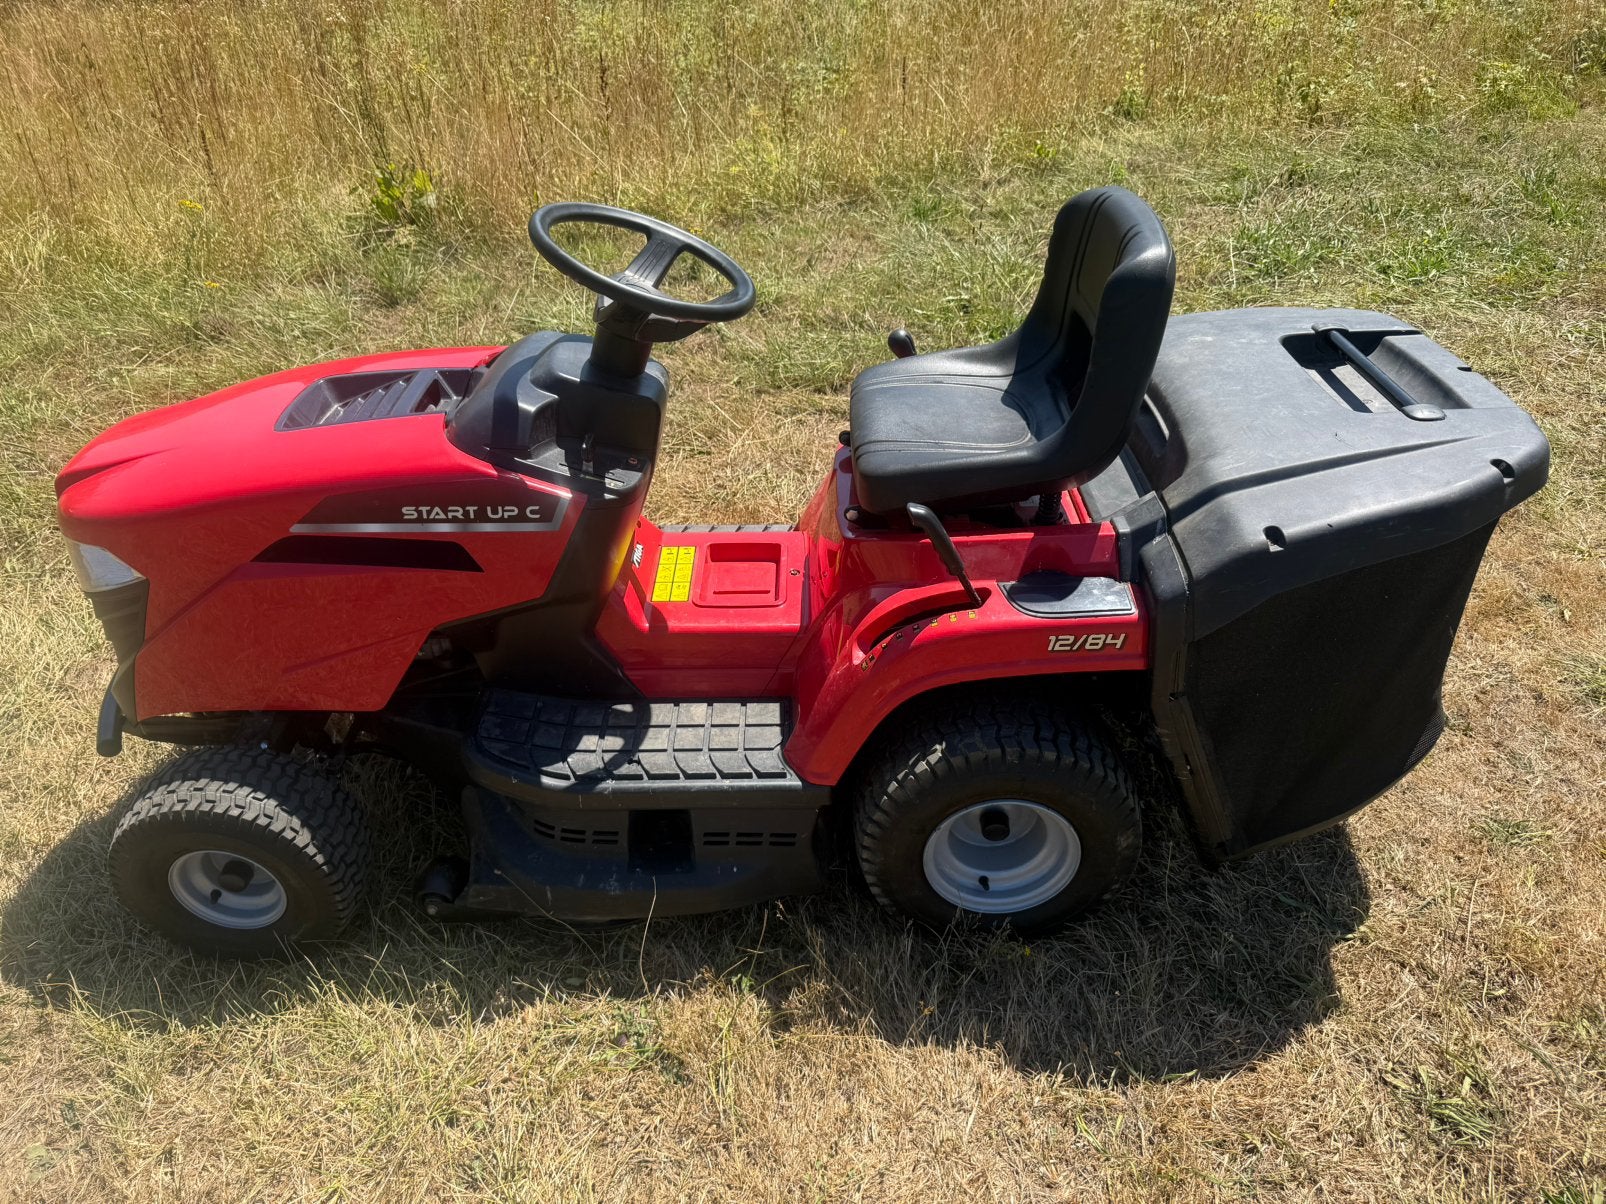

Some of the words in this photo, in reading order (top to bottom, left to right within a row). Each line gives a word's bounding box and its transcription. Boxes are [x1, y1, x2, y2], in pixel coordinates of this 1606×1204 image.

[401, 505, 478, 520] START
[486, 505, 519, 519] UP
[525, 505, 541, 519] C
[1047, 633, 1126, 651] 12/84
